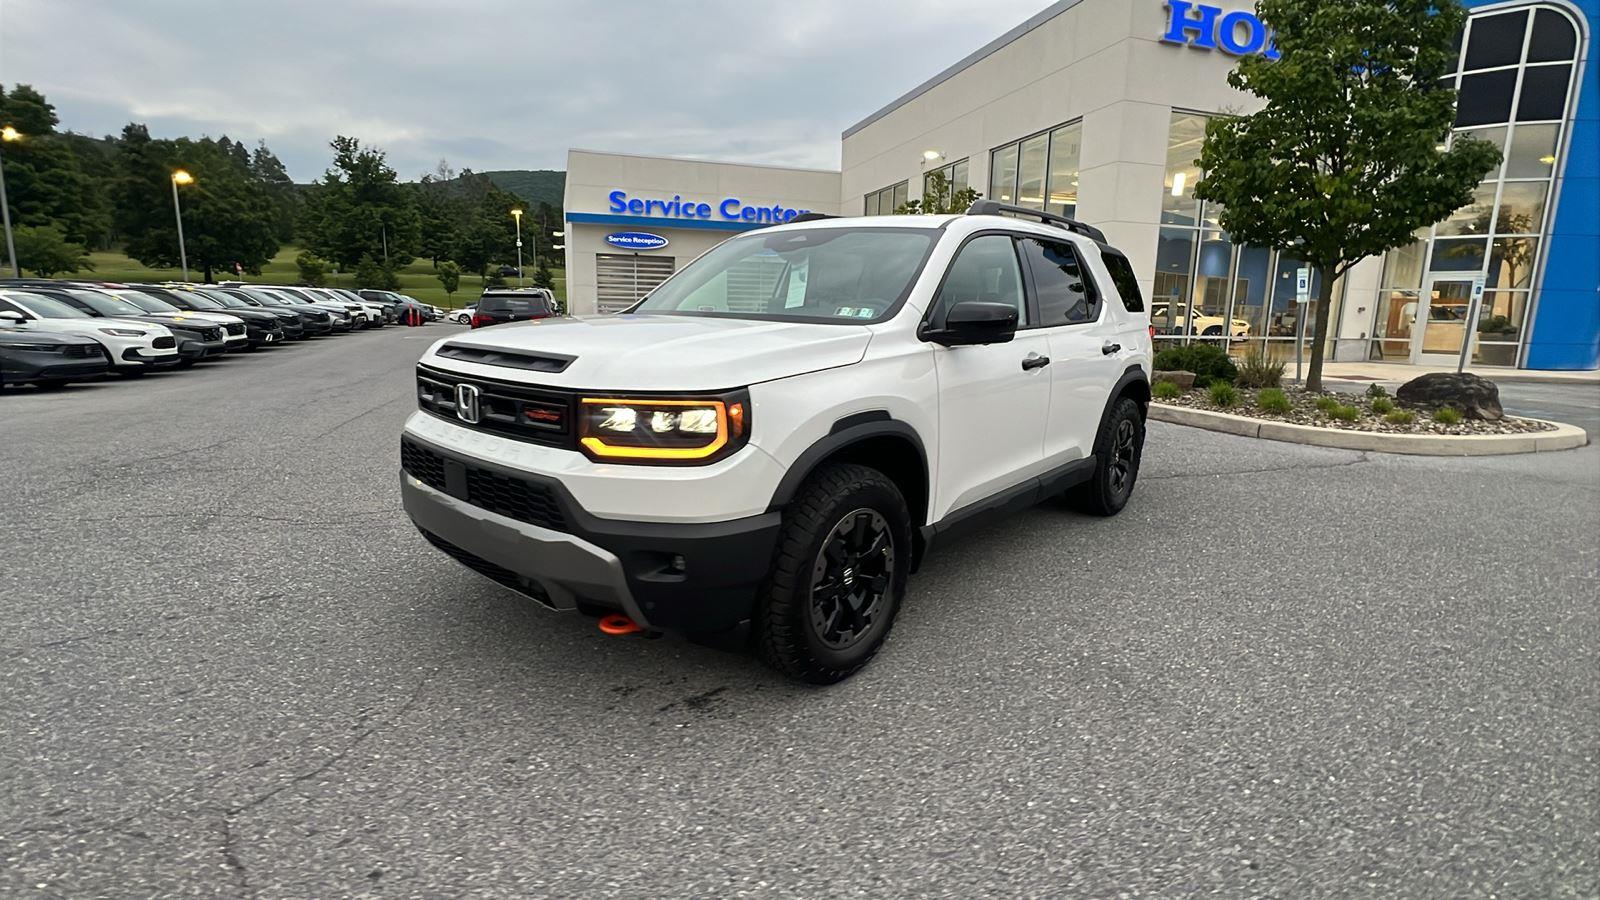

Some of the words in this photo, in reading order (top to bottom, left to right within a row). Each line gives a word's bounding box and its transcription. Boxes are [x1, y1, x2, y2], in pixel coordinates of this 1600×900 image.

[1164, 0, 1281, 61] HO
[609, 190, 712, 219] Service
[608, 235, 632, 243] Service
[633, 237, 664, 245] Reception
